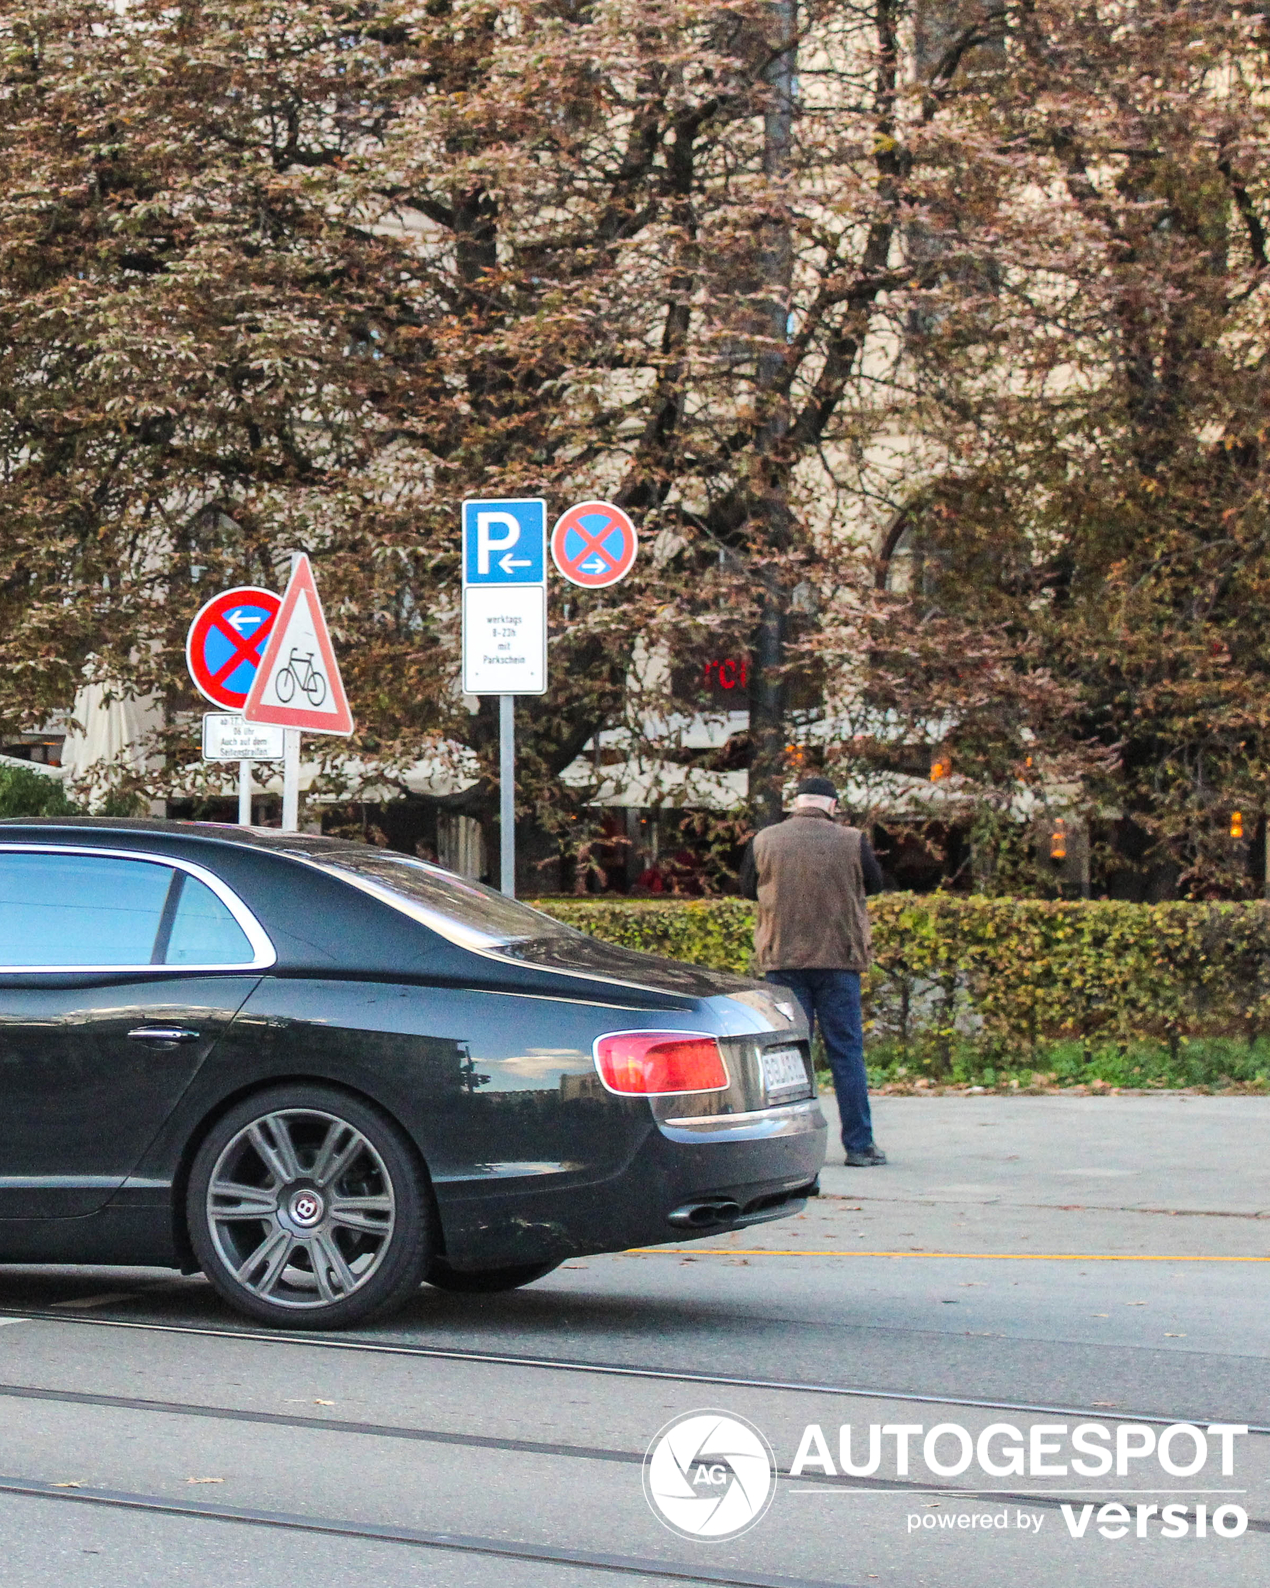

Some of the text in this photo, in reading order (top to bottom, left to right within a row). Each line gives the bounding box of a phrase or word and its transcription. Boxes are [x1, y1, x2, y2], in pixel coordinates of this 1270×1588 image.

[477, 511, 520, 574] P
[486, 614, 522, 626] werktags
[497, 642, 511, 650] mit
[483, 654, 526, 664] Parkschein
[221, 737, 267, 746] Auch auf dem
